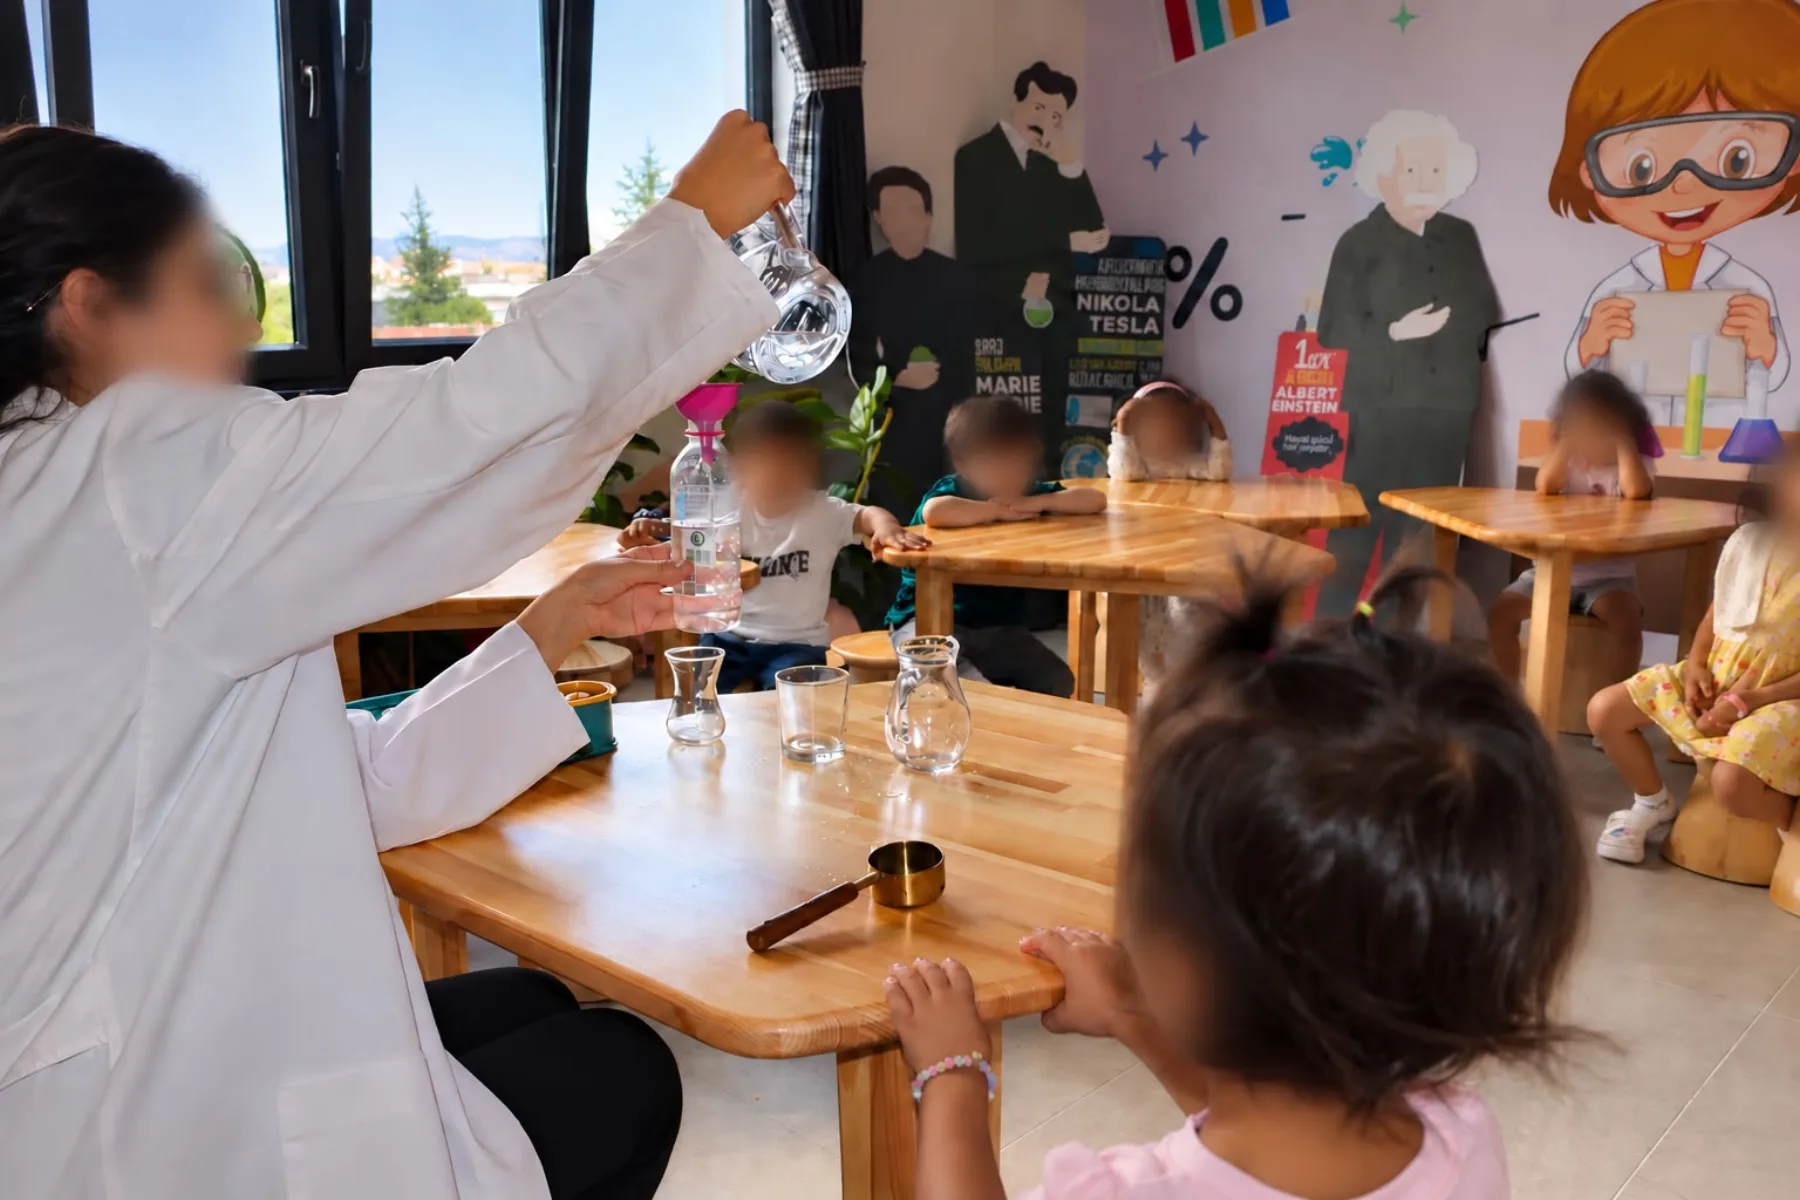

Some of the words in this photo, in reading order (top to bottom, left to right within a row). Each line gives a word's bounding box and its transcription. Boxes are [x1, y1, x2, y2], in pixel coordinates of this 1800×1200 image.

[1077, 293, 1160, 313] NIKOLA
[1089, 315, 1160, 335] TESLA
[976, 375, 1042, 395] MARIE
[1275, 386, 1338, 400] ALBERT
[1271, 399, 1339, 414] EINSTEIN
